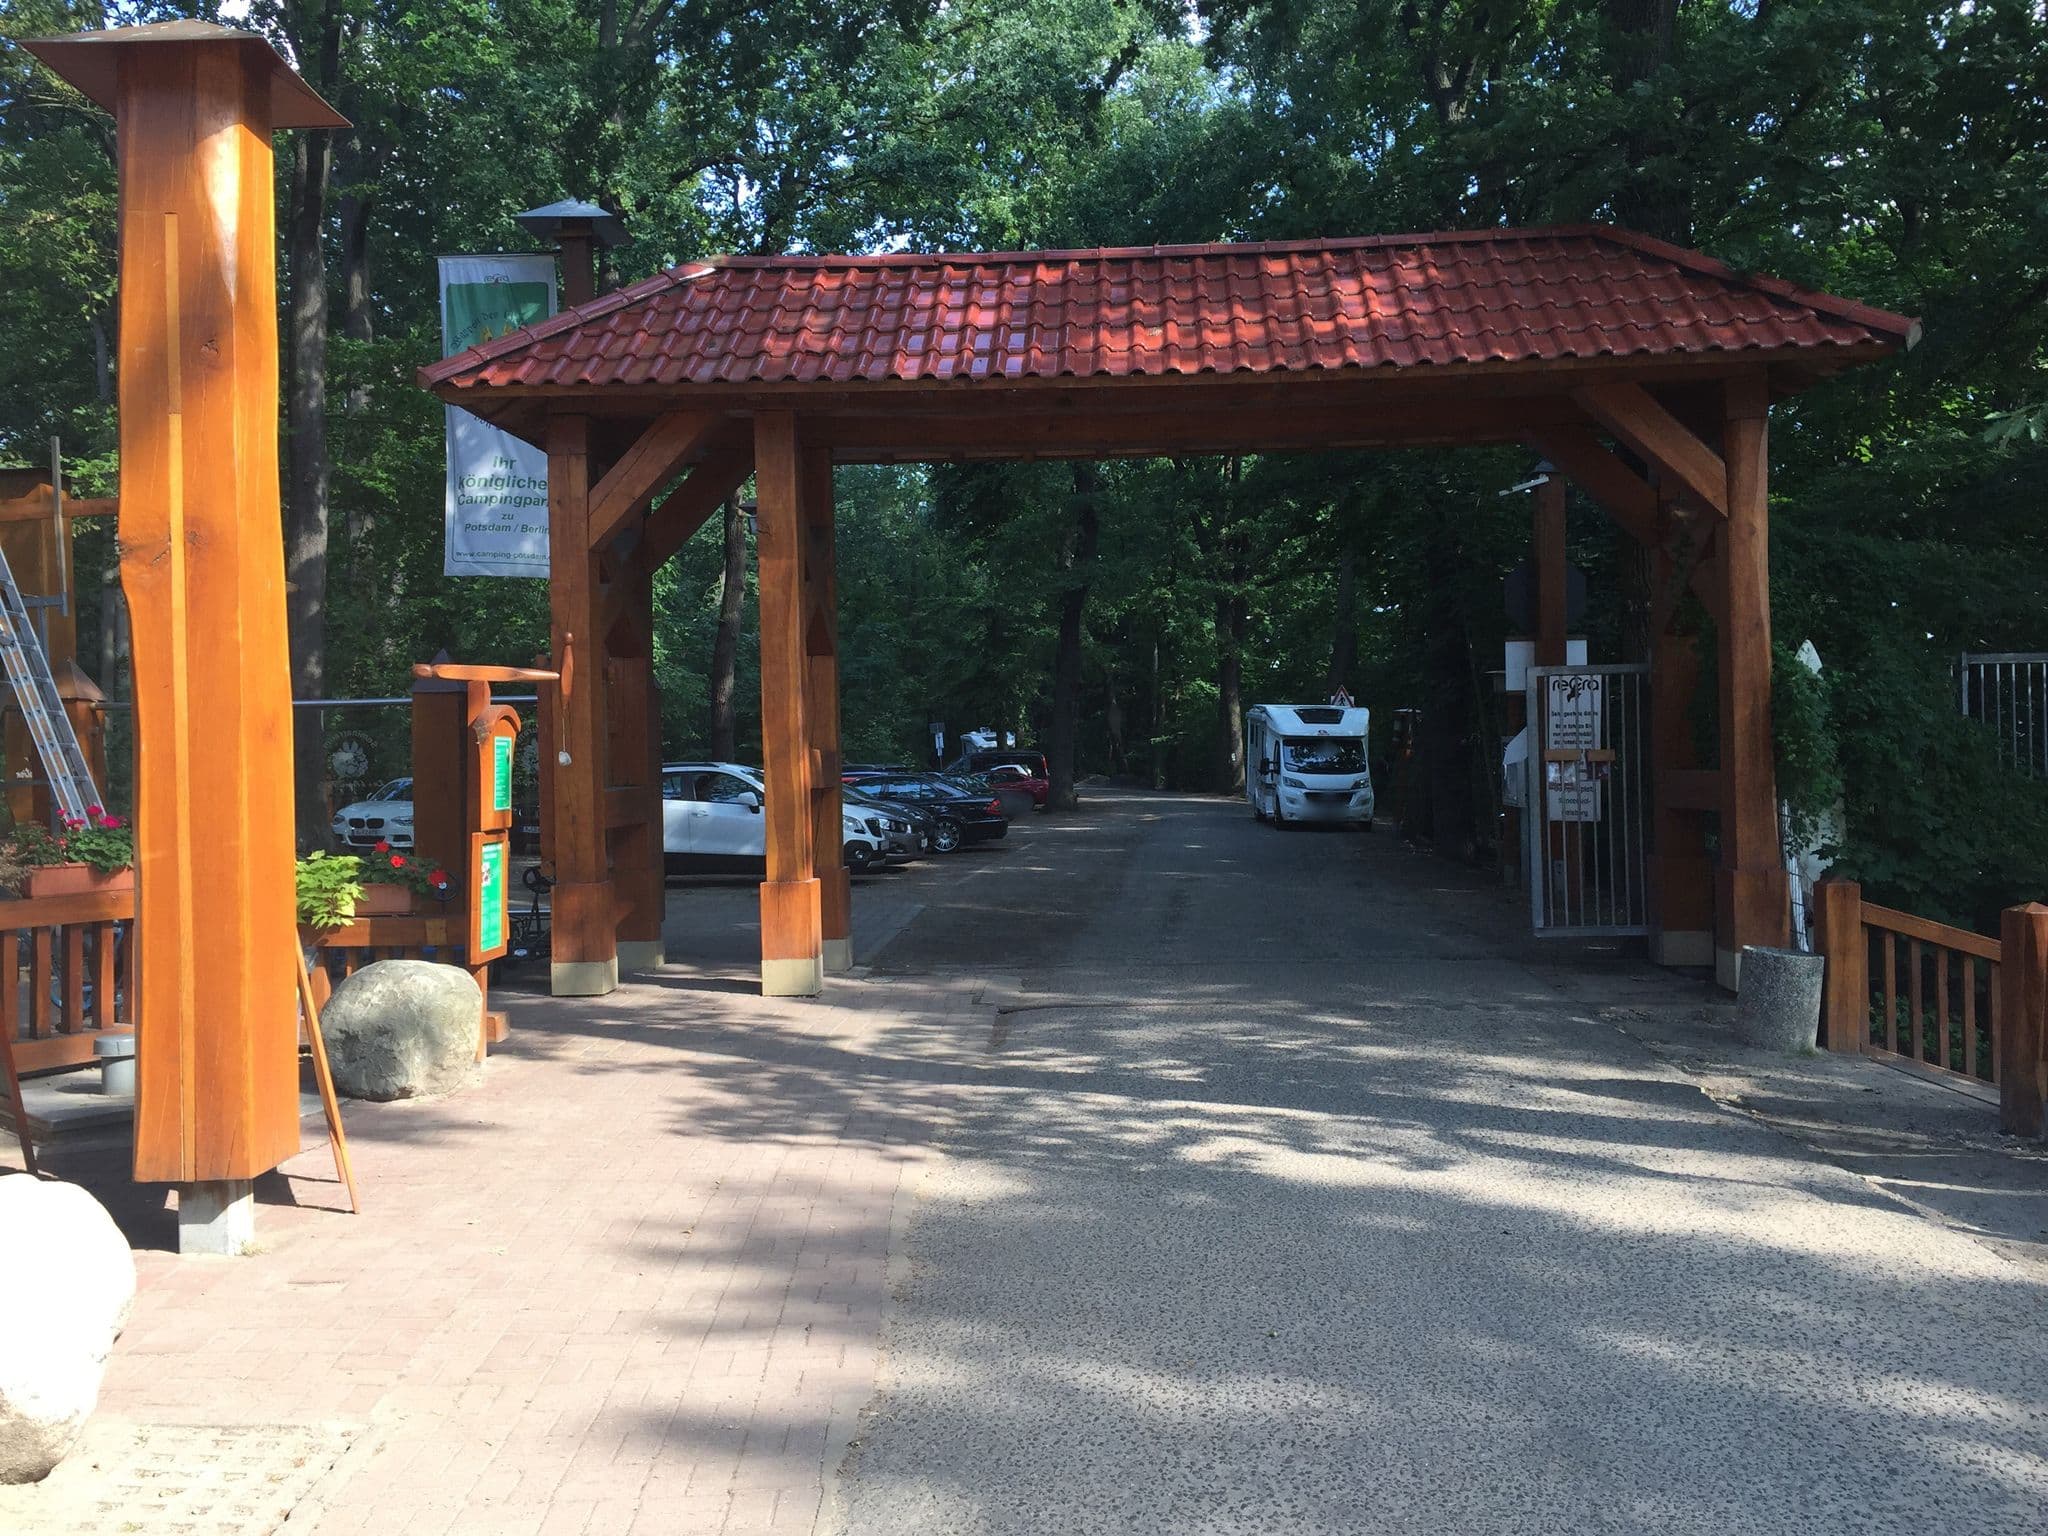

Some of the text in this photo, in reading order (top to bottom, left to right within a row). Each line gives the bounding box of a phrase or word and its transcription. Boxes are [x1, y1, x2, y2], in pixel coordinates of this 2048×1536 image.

[493, 455, 517, 470] Ihr
[457, 493, 549, 508] Campingpar
[501, 512, 514, 521] zu
[464, 523, 512, 534] Potsdam
